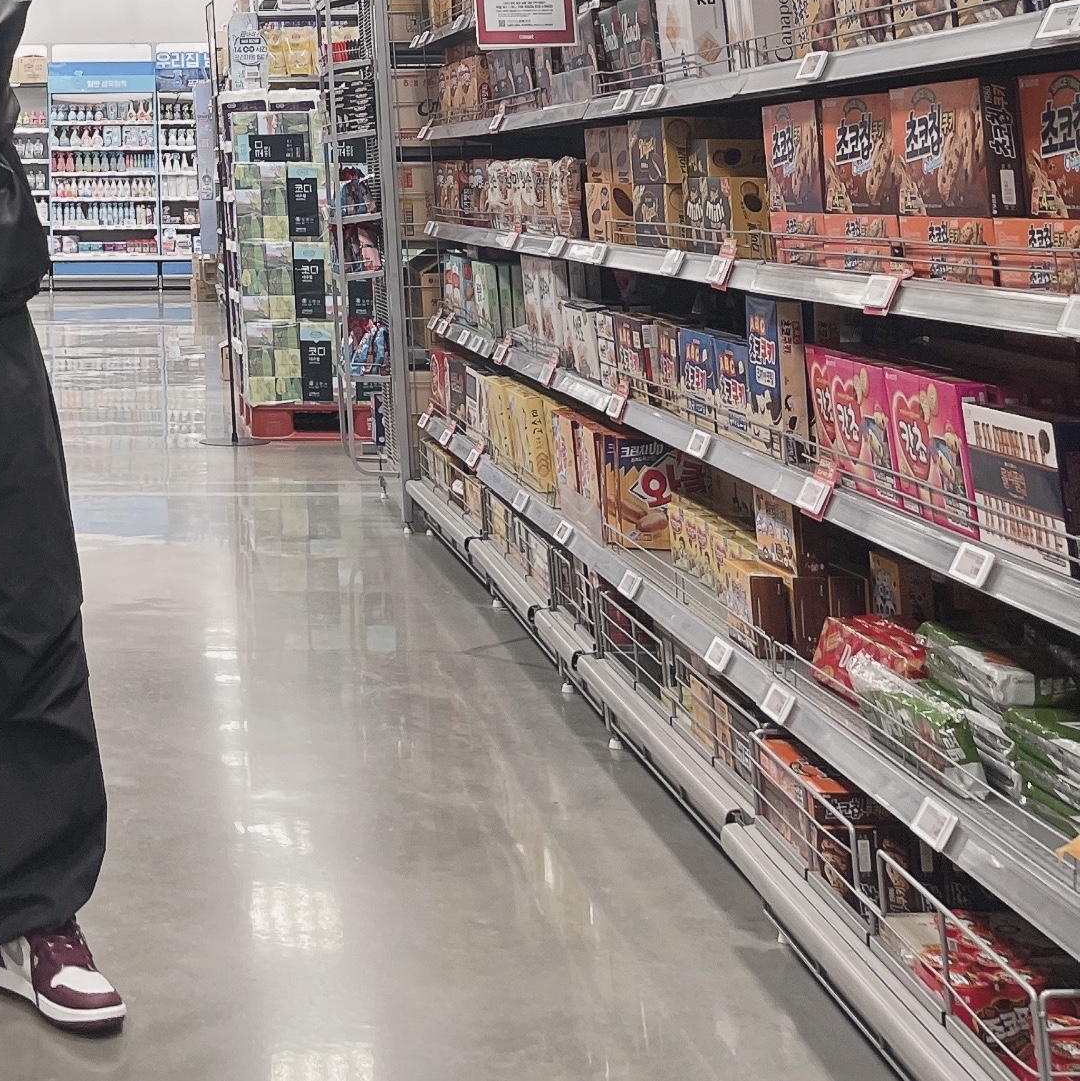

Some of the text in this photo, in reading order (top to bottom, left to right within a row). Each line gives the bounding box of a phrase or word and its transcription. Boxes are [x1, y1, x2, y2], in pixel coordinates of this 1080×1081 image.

[156, 51, 202, 69] 우리집
[834, 111, 873, 166] 초코칩
[903, 101, 943, 164] 초코칩
[836, 402, 860, 443] 칸쵸
[898, 420, 929, 464] 칸쵸
